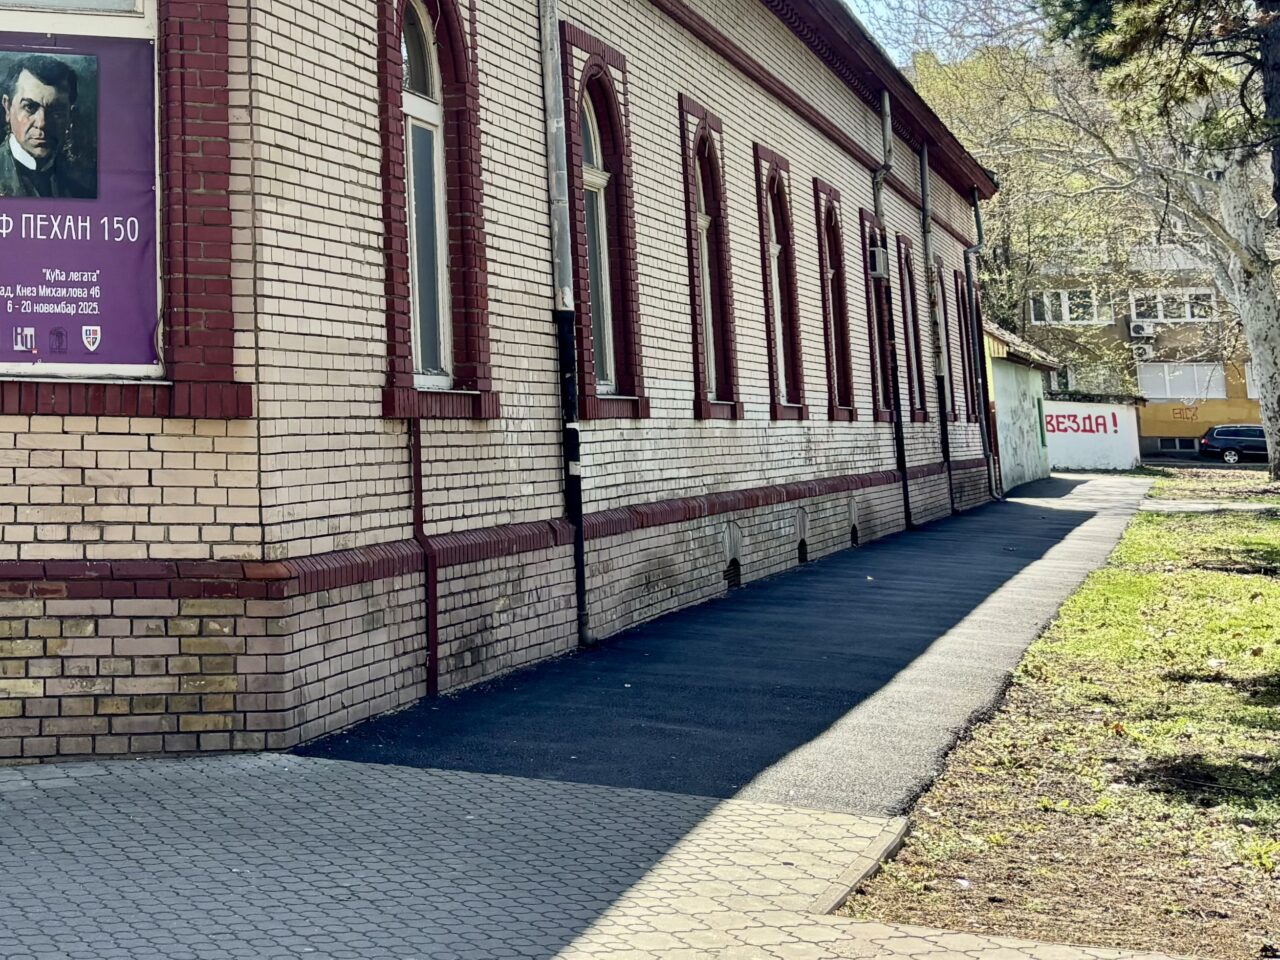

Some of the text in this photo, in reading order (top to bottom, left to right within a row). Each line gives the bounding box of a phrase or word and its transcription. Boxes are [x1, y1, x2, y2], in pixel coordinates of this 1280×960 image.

[21, 213, 91, 240] ПЕХАН
[100, 216, 139, 242] 150
[16, 285, 36, 296] Кнез
[38, 286, 87, 298] Михаилова
[89, 286, 101, 298] 46
[7, 301, 13, 312] 6
[21, 301, 31, 313] 20
[34, 302, 76, 315] новембар
[78, 303, 101, 314] 2025.
